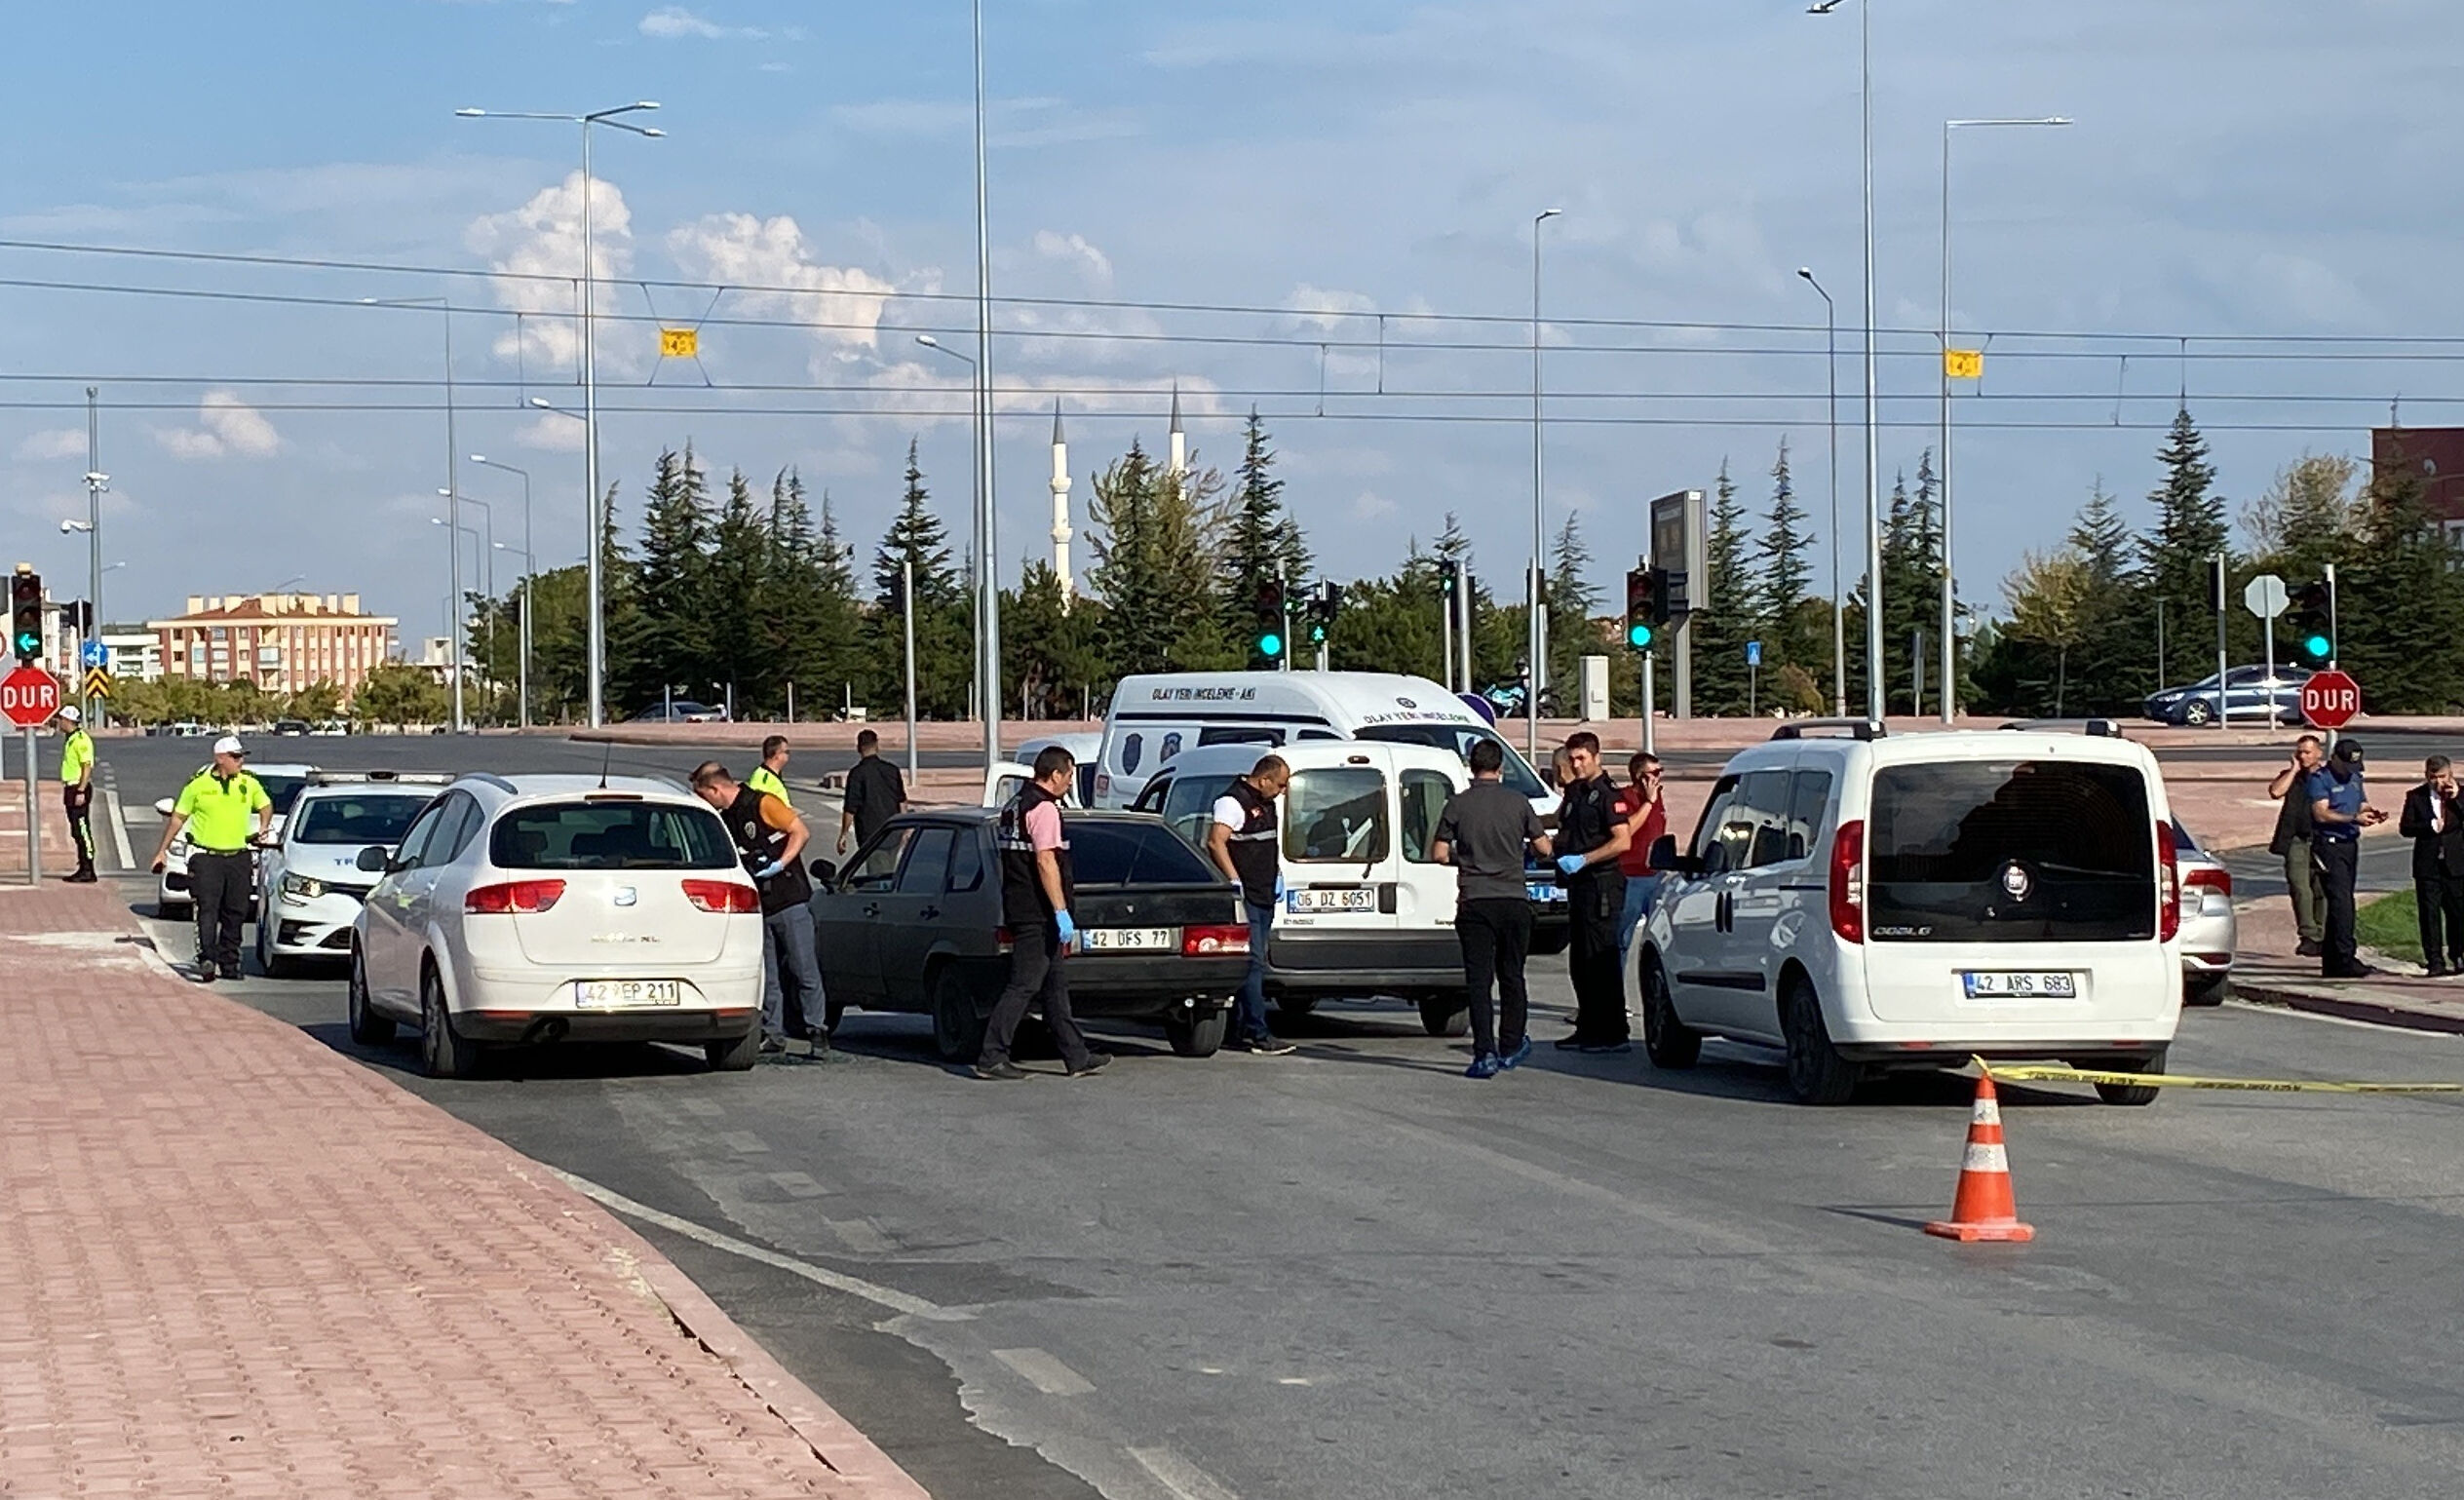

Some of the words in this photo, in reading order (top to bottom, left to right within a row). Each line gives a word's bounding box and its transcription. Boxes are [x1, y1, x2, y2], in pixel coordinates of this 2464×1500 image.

[3, 685, 55, 709] DUR
[2306, 688, 2355, 711] DUR
[1297, 892, 1312, 906] 06
[1321, 892, 1335, 906] DZ
[1092, 931, 1107, 946] 42
[1117, 931, 1141, 946] DFS
[1152, 931, 1167, 945] 77
[586, 984, 607, 1000] 42
[647, 982, 674, 999] 211
[1977, 976, 1994, 991] 42
[2007, 976, 2033, 991] ARS
[2044, 976, 2070, 991] 683
